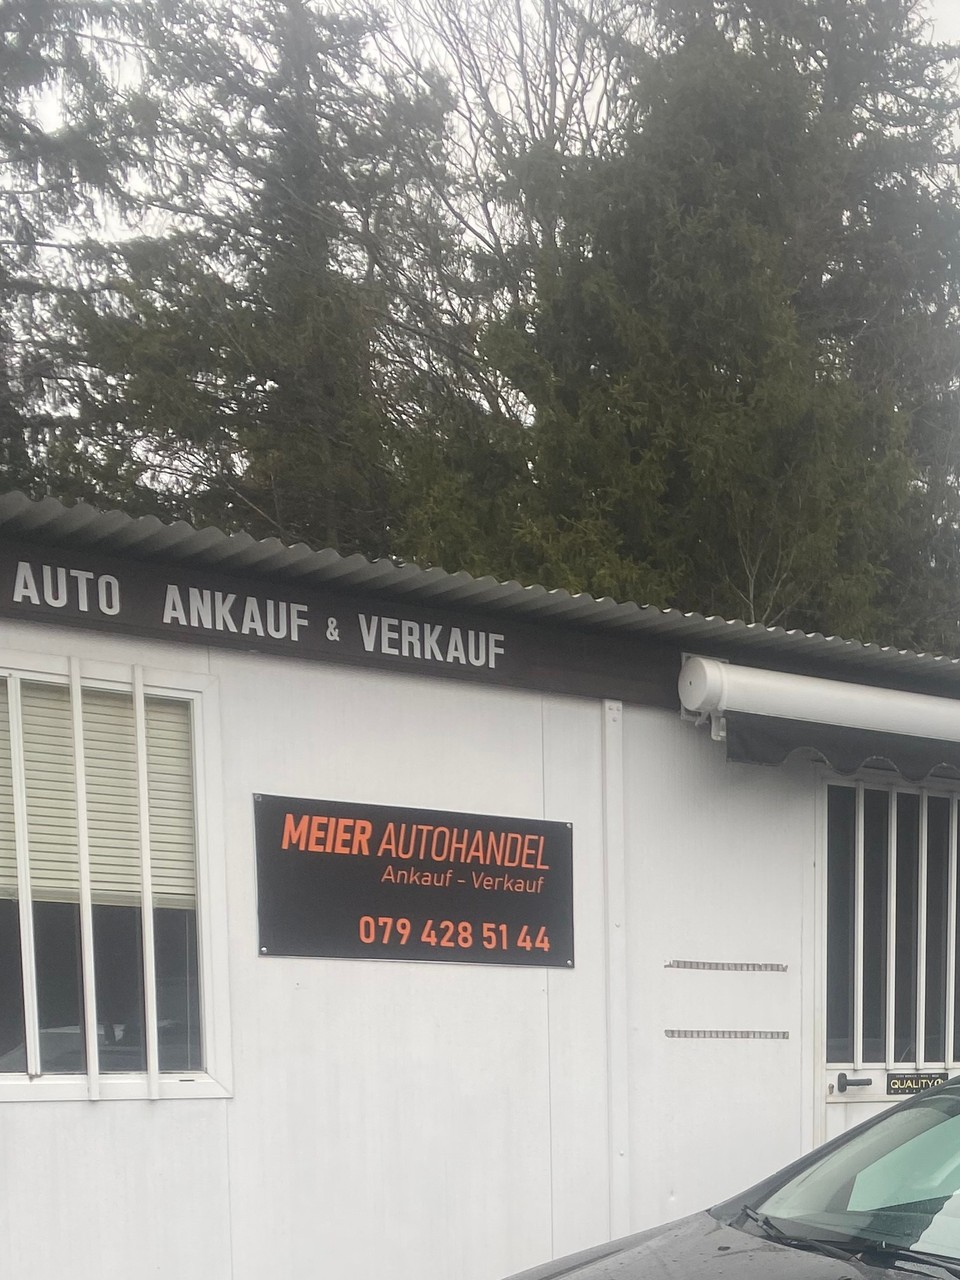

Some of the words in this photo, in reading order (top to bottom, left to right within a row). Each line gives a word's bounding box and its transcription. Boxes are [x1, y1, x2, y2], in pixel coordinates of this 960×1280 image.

[13, 561, 120, 616] AUTO
[163, 584, 308, 641] ANKAUF
[325, 616, 340, 642] &
[358, 613, 505, 669] VERKAUF
[281, 813, 373, 856] MEIER
[377, 822, 550, 870] AUTOHANDEL
[381, 865, 453, 887] Ankauf
[471, 871, 545, 894] Verkauf
[359, 915, 412, 946] 079
[421, 919, 473, 949] 428
[482, 922, 508, 950] 51
[517, 926, 551, 952] 44
